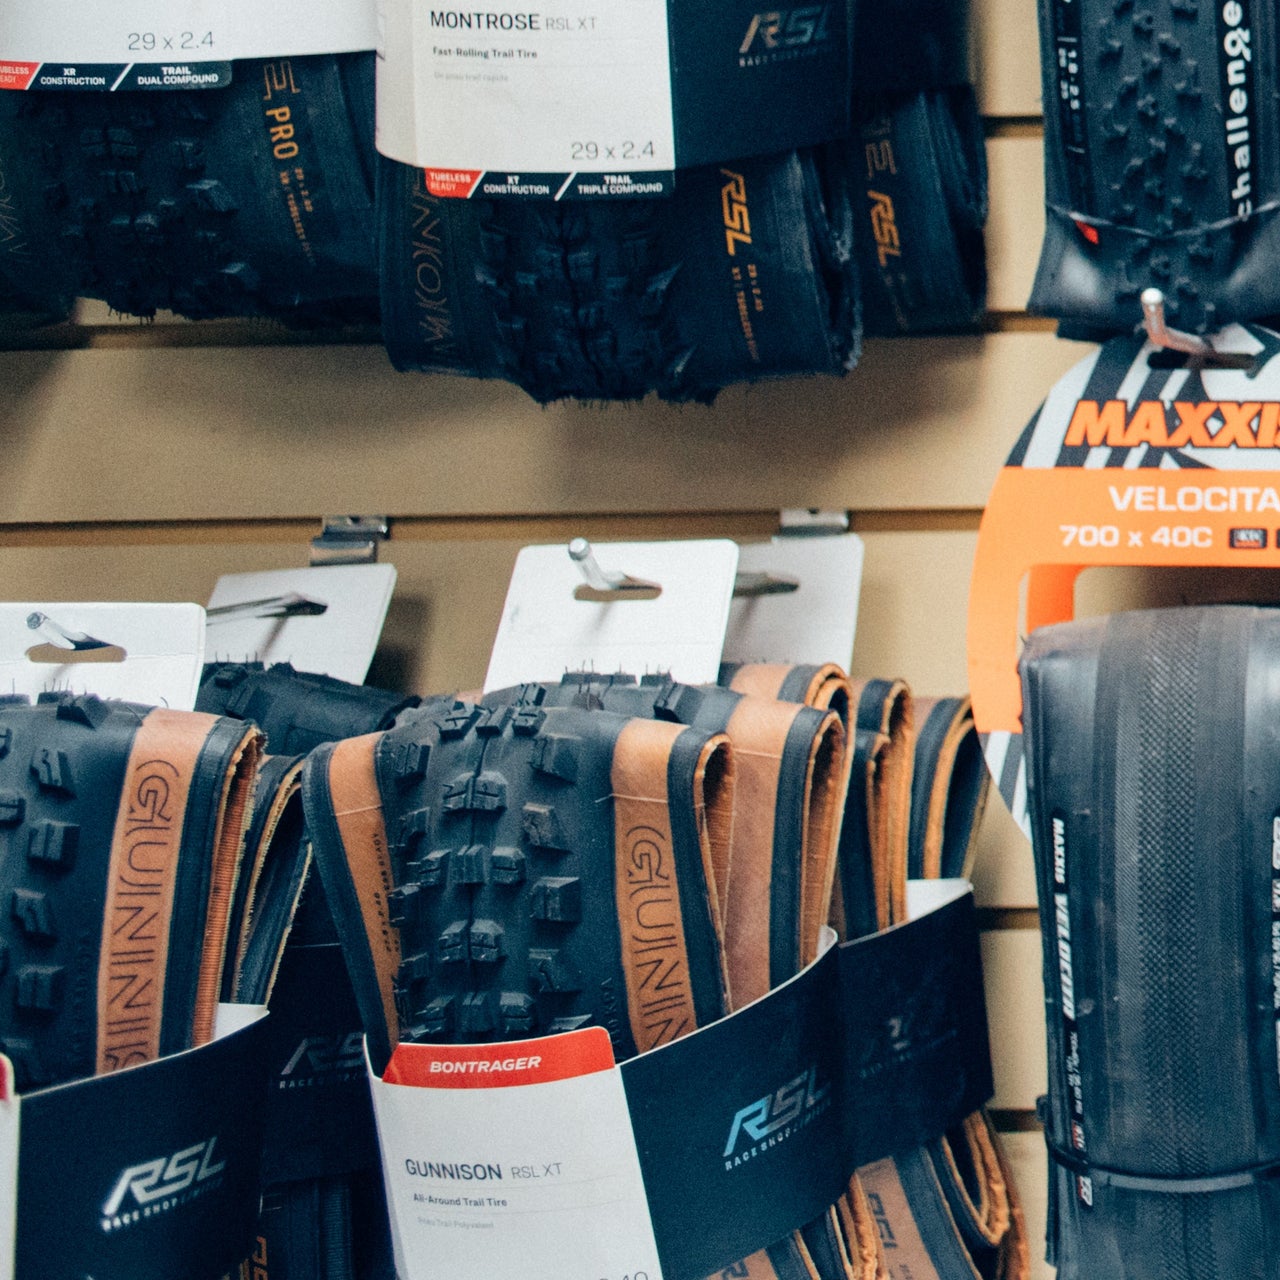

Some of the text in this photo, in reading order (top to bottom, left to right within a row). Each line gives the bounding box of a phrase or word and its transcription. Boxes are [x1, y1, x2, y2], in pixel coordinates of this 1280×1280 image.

[430, 10, 599, 32] MONTROSE RSL XT
[128, 31, 216, 51] 29 2.4
[491, 47, 539, 60] Trail Tire
[40, 76, 106, 86] CONSTRUCTION
[63, 68, 77, 77] XR
[137, 73, 219, 86] DUAL COMPOUND
[161, 66, 192, 76] TRAIL
[1223, 0, 1253, 220] challenge
[265, 105, 300, 161] PRO
[571, 139, 656, 161] 29 2.4
[429, 173, 472, 184] TUBELESS
[577, 182, 663, 195] TRIPLE COMPOUND
[603, 174, 633, 185] TRAIL
[483, 184, 550, 195] CONSTRUCTION
[720, 167, 753, 257] RSL
[1059, 525, 1120, 548] 700
[1127, 531, 1143, 547] x
[1151, 526, 1213, 548] 40C
[1054, 893, 1076, 1021] VELOCITA
[429, 1053, 542, 1074] BONTRAGER
[721, 1068, 832, 1158] RSL
[405, 1158, 563, 1181] GUNNISON RSL XT
[724, 1146, 759, 1172] RACE
[102, 1135, 227, 1218] RSL
[413, 1192, 508, 1208] All-Around Trail Tire
